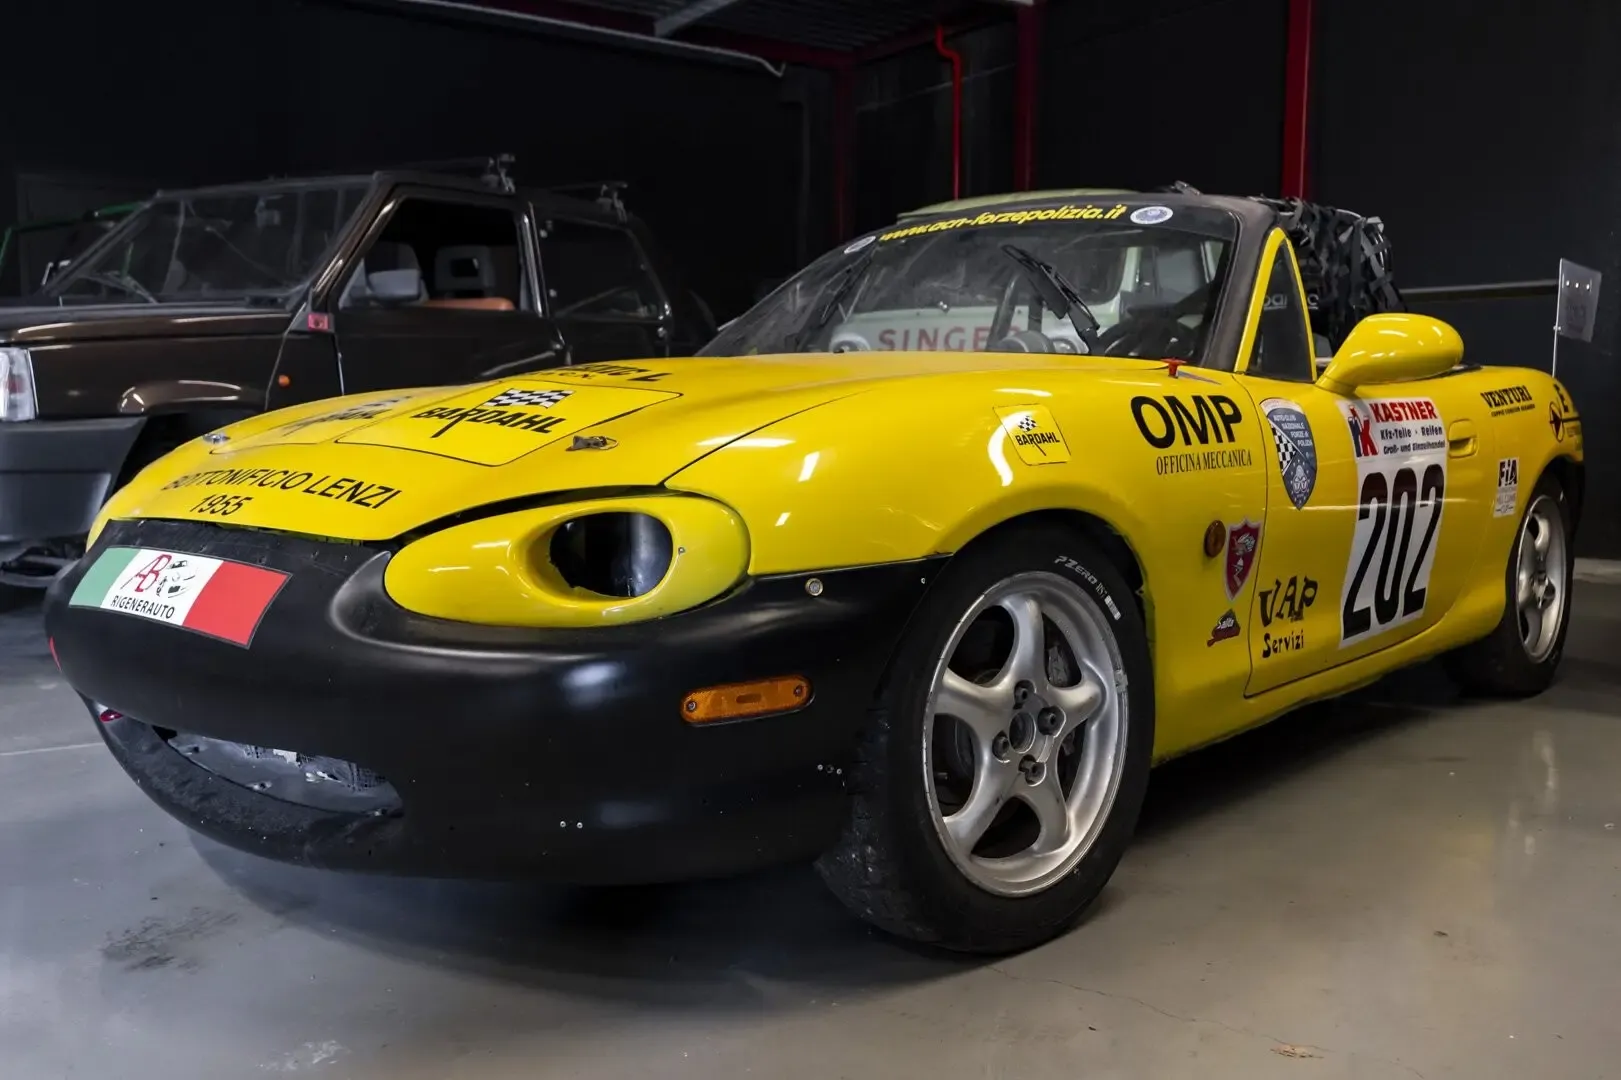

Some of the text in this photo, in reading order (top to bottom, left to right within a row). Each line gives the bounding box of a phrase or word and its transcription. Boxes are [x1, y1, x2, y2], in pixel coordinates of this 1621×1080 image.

[878, 203, 1128, 242] www.acn-forzepolizia.it
[1480, 385, 1533, 409] VENTURI
[410, 406, 567, 437] BARDAHL
[1130, 395, 1243, 449] OMP
[1369, 401, 1438, 423] KASTNER
[1014, 432, 1061, 450] BARDAHL
[1421, 425, 1443, 437] Reifen
[1400, 443, 1411, 452] und
[1156, 449, 1252, 476] OFFICINA MECCANICA
[160, 468, 403, 509] BOTTONIFICIO LENZI
[189, 493, 254, 516] 1955
[1342, 464, 1445, 641] 202
[110, 595, 175, 619] RIGENERAUTO
[1261, 627, 1304, 659] Servizi
